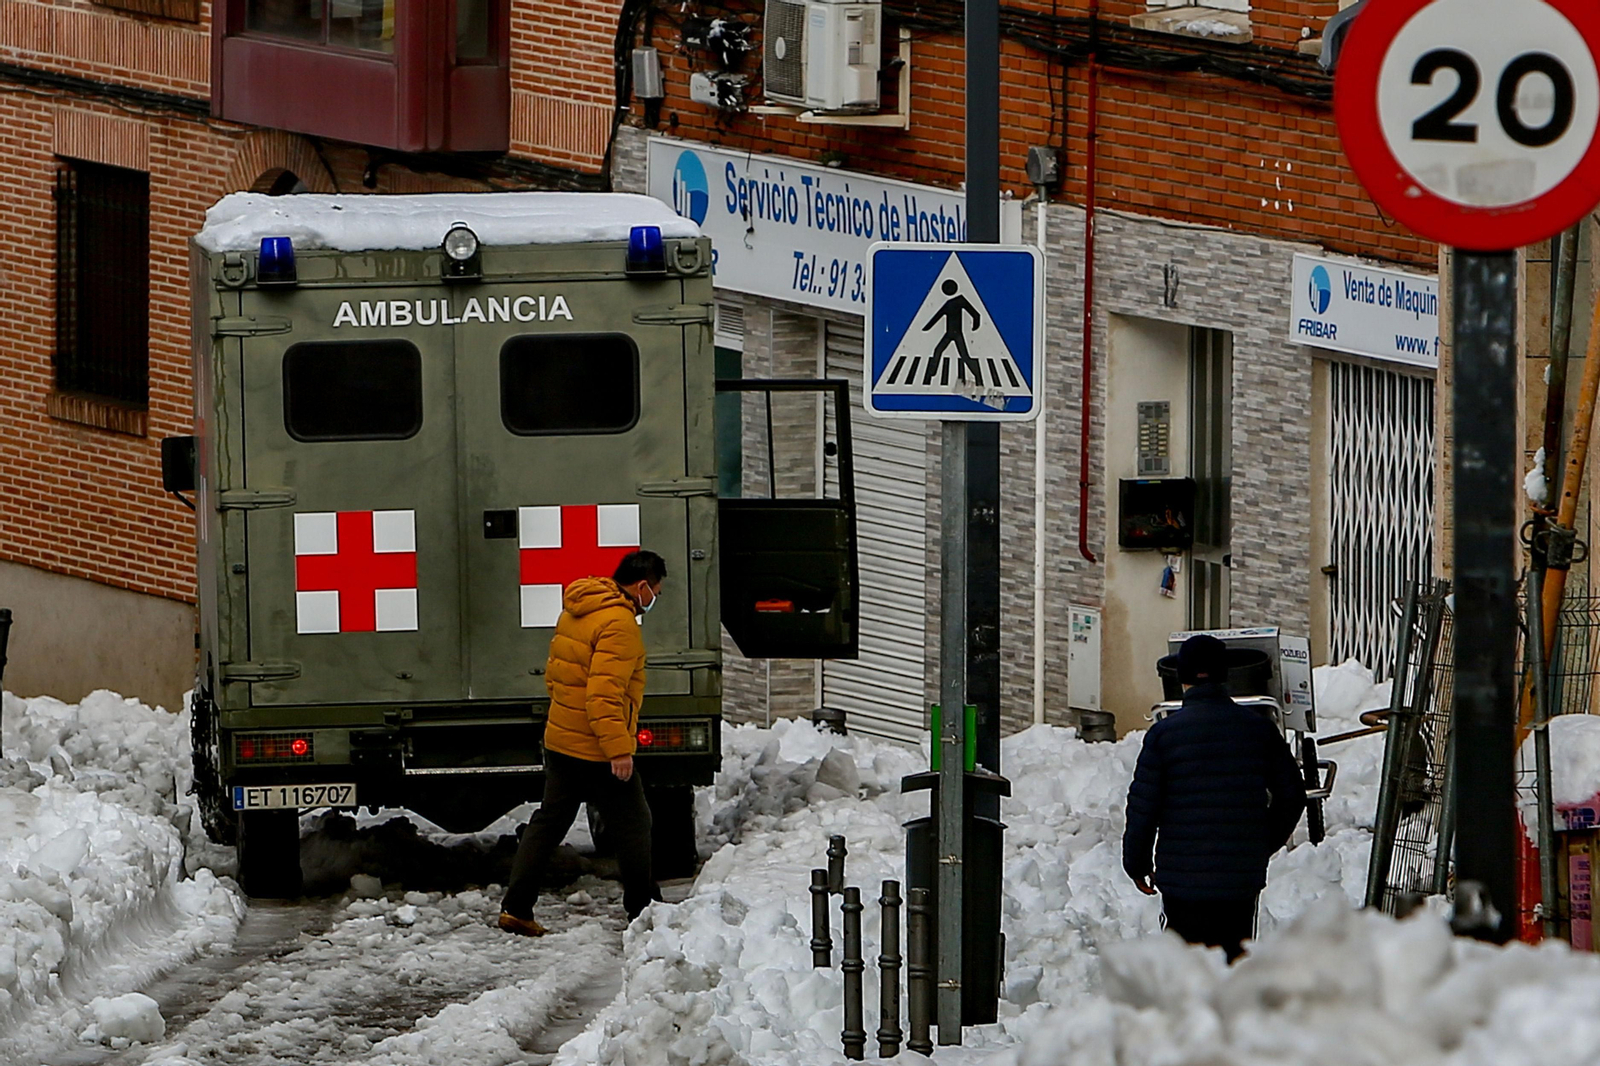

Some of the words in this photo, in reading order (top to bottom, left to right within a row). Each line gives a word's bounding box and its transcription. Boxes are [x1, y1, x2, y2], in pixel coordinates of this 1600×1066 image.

[1410, 47, 1577, 148] 20
[726, 161, 798, 225] Servicio
[801, 175, 874, 239] Técnico
[879, 190, 900, 242] de
[904, 194, 967, 242] Hostel
[793, 251, 825, 294] Tel.:
[828, 259, 848, 299] 91
[1343, 270, 1375, 305] Venta
[1378, 278, 1392, 307] de
[1395, 280, 1437, 320] Maquin
[332, 295, 574, 327] AMBULANCIA
[1298, 318, 1337, 340] FRIBAR
[1280, 648, 1308, 659] POZUELO
[247, 788, 272, 806] ET
[280, 786, 352, 806] 116707
